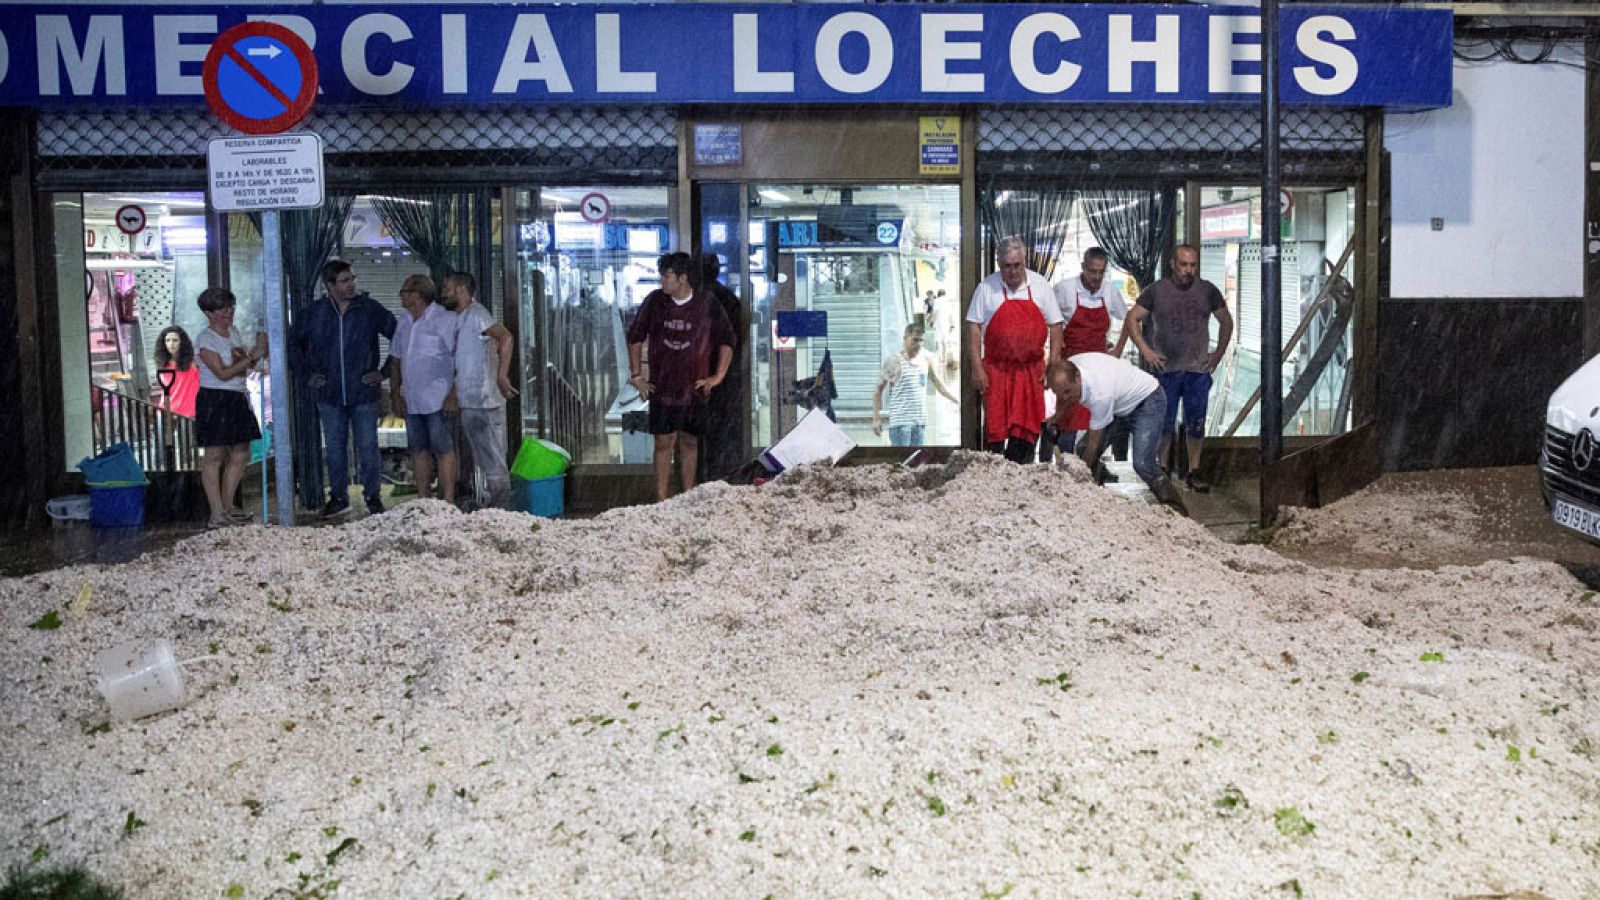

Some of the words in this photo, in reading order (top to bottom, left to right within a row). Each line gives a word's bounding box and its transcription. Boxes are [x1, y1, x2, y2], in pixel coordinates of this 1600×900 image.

[0, 13, 656, 96] MECIAL
[733, 11, 1358, 96] LOECHES
[225, 139, 256, 147] RESERVA
[258, 138, 302, 146] COMPARTIDA
[242, 157, 287, 166] LABORABLES
[234, 170, 240, 178] A
[264, 169, 273, 177] DE
[215, 180, 246, 188] EXCEPTO
[248, 179, 271, 187] CARGA
[280, 177, 316, 185] DESCARGA
[233, 188, 256, 196] RESTO
[258, 188, 267, 196] DE
[270, 186, 299, 195] HORARIO
[879, 226, 896, 238] 22
[1557, 502, 1581, 528] 0919
